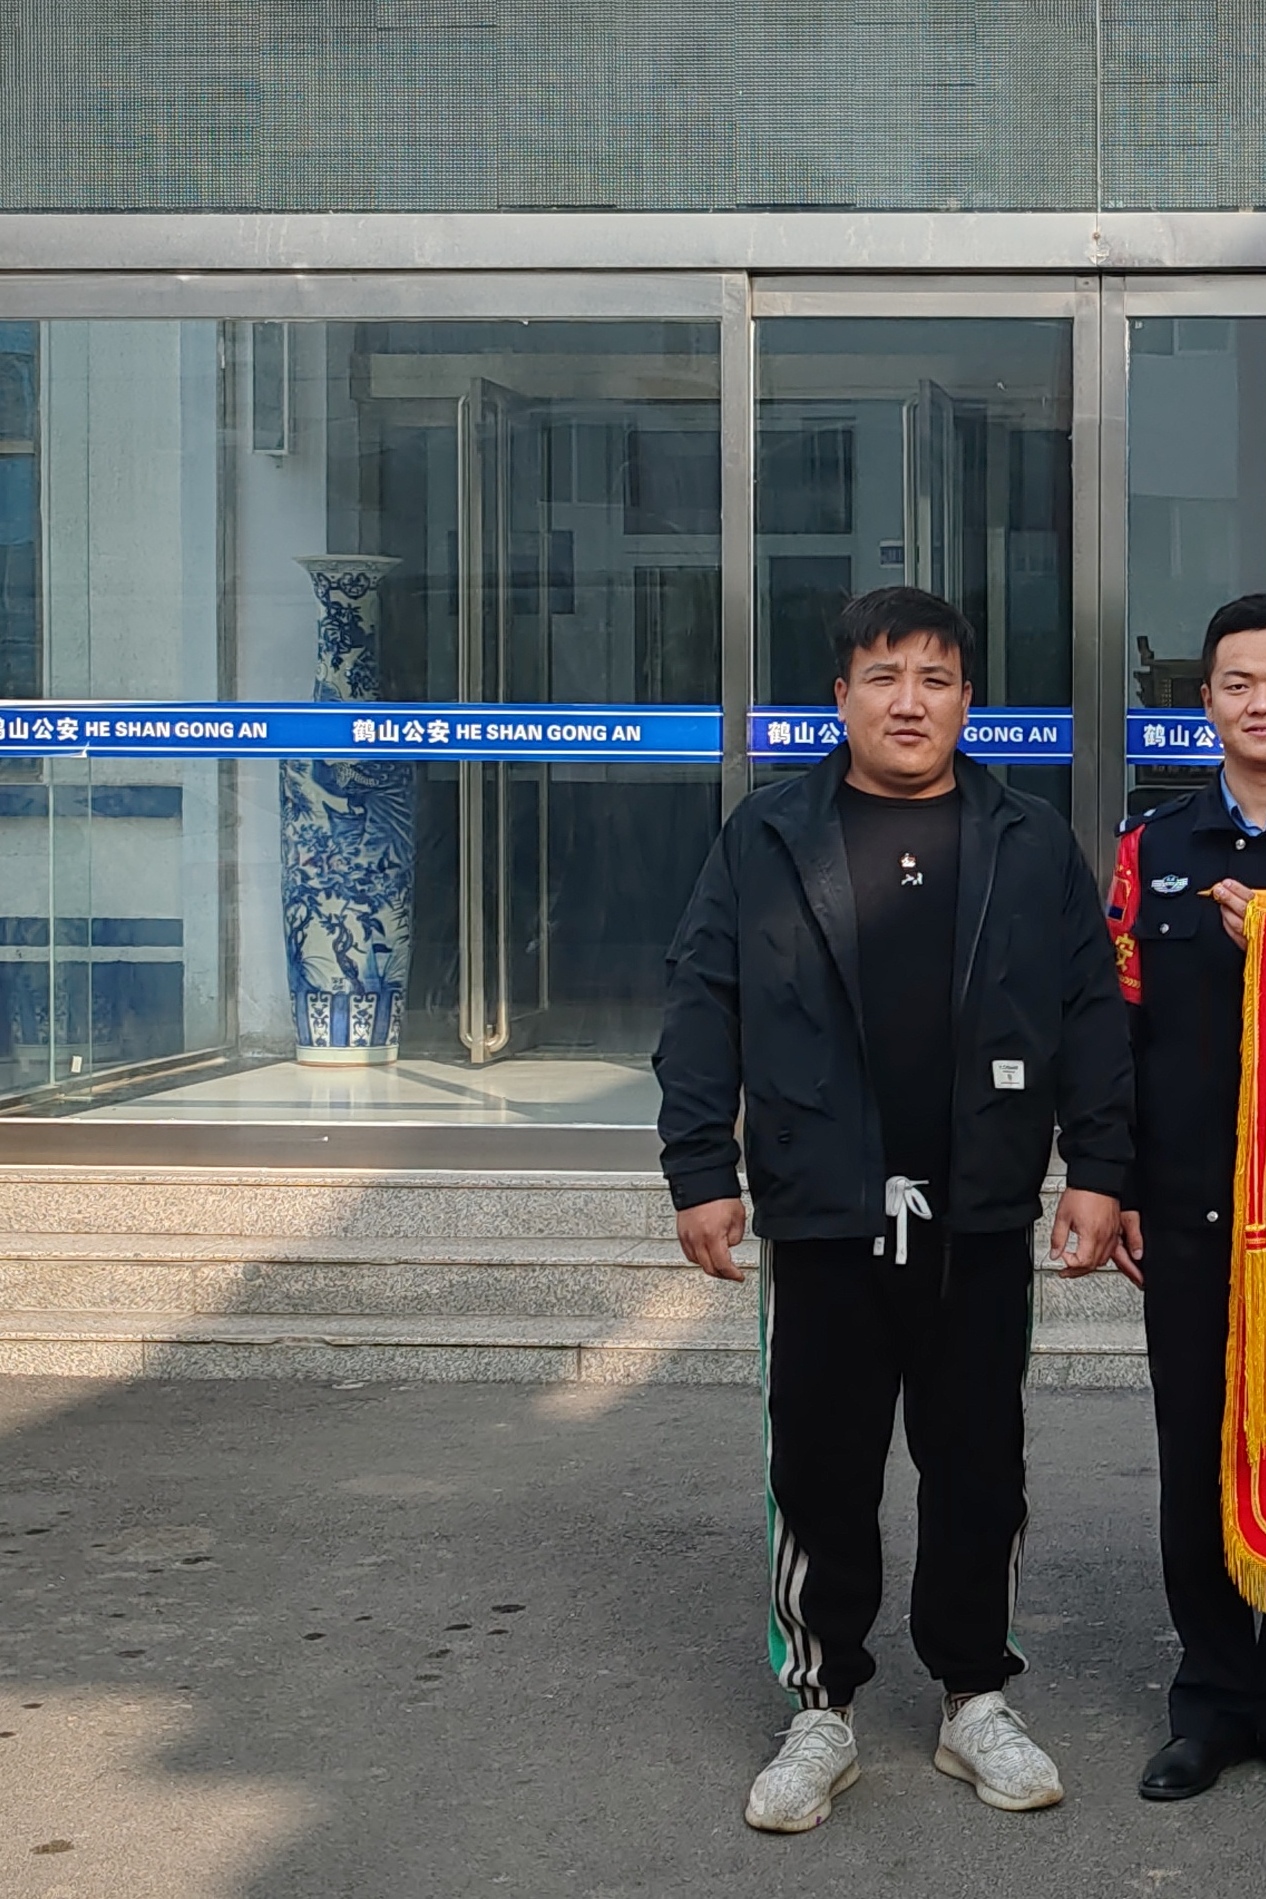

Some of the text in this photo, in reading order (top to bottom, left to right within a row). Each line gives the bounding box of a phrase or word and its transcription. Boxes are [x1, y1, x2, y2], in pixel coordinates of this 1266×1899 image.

[0, 716, 79, 741] 山公安
[85, 721, 267, 739] HE SHAN GONG AN
[352, 719, 450, 744] 鹤山公安
[456, 724, 641, 741] HE SHAN GONG AN
[767, 721, 848, 745] 鹤山公
[963, 726, 1058, 743] GONG AN
[1143, 724, 1224, 748] 鹤山公
